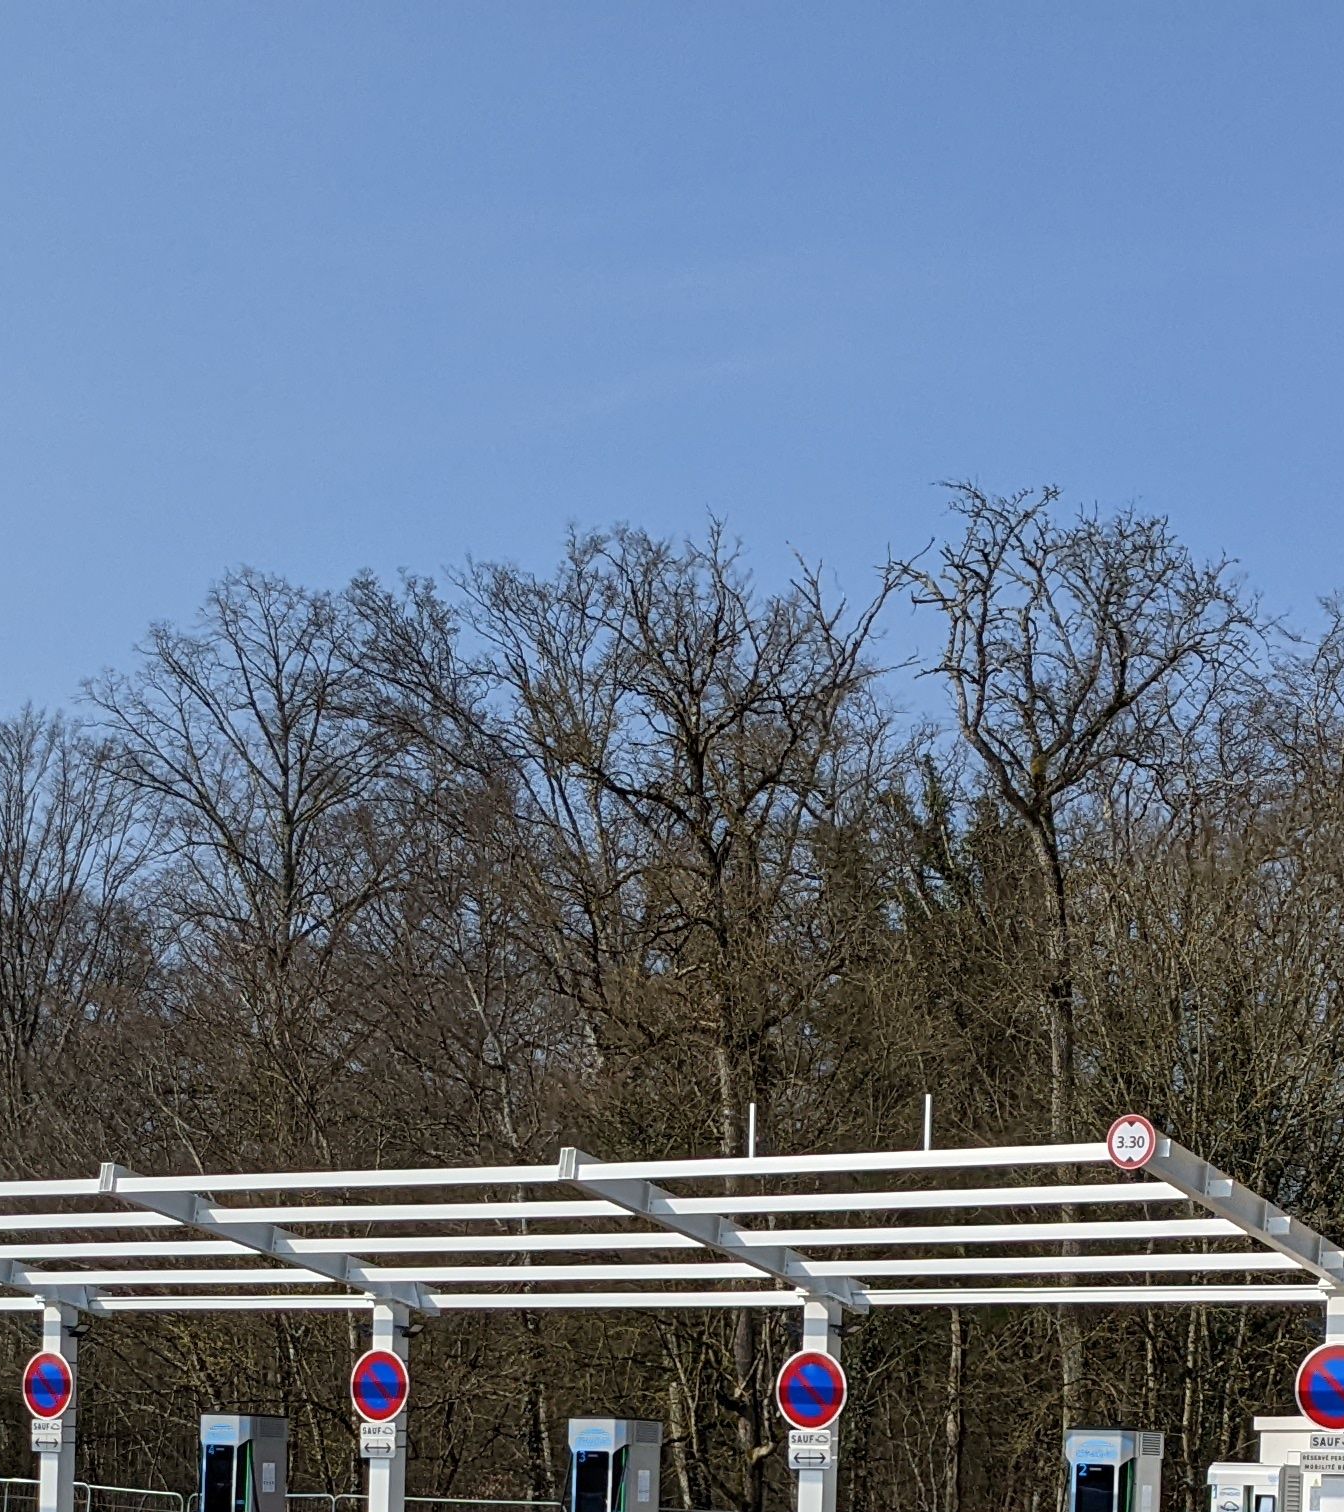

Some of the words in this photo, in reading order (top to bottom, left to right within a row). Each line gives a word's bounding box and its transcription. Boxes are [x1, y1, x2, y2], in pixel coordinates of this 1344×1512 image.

[1116, 1135, 1146, 1149] 3.30
[791, 1435, 814, 1443] SAUF
[1312, 1436, 1341, 1447] SAUF
[1079, 1464, 1088, 1476] 2
